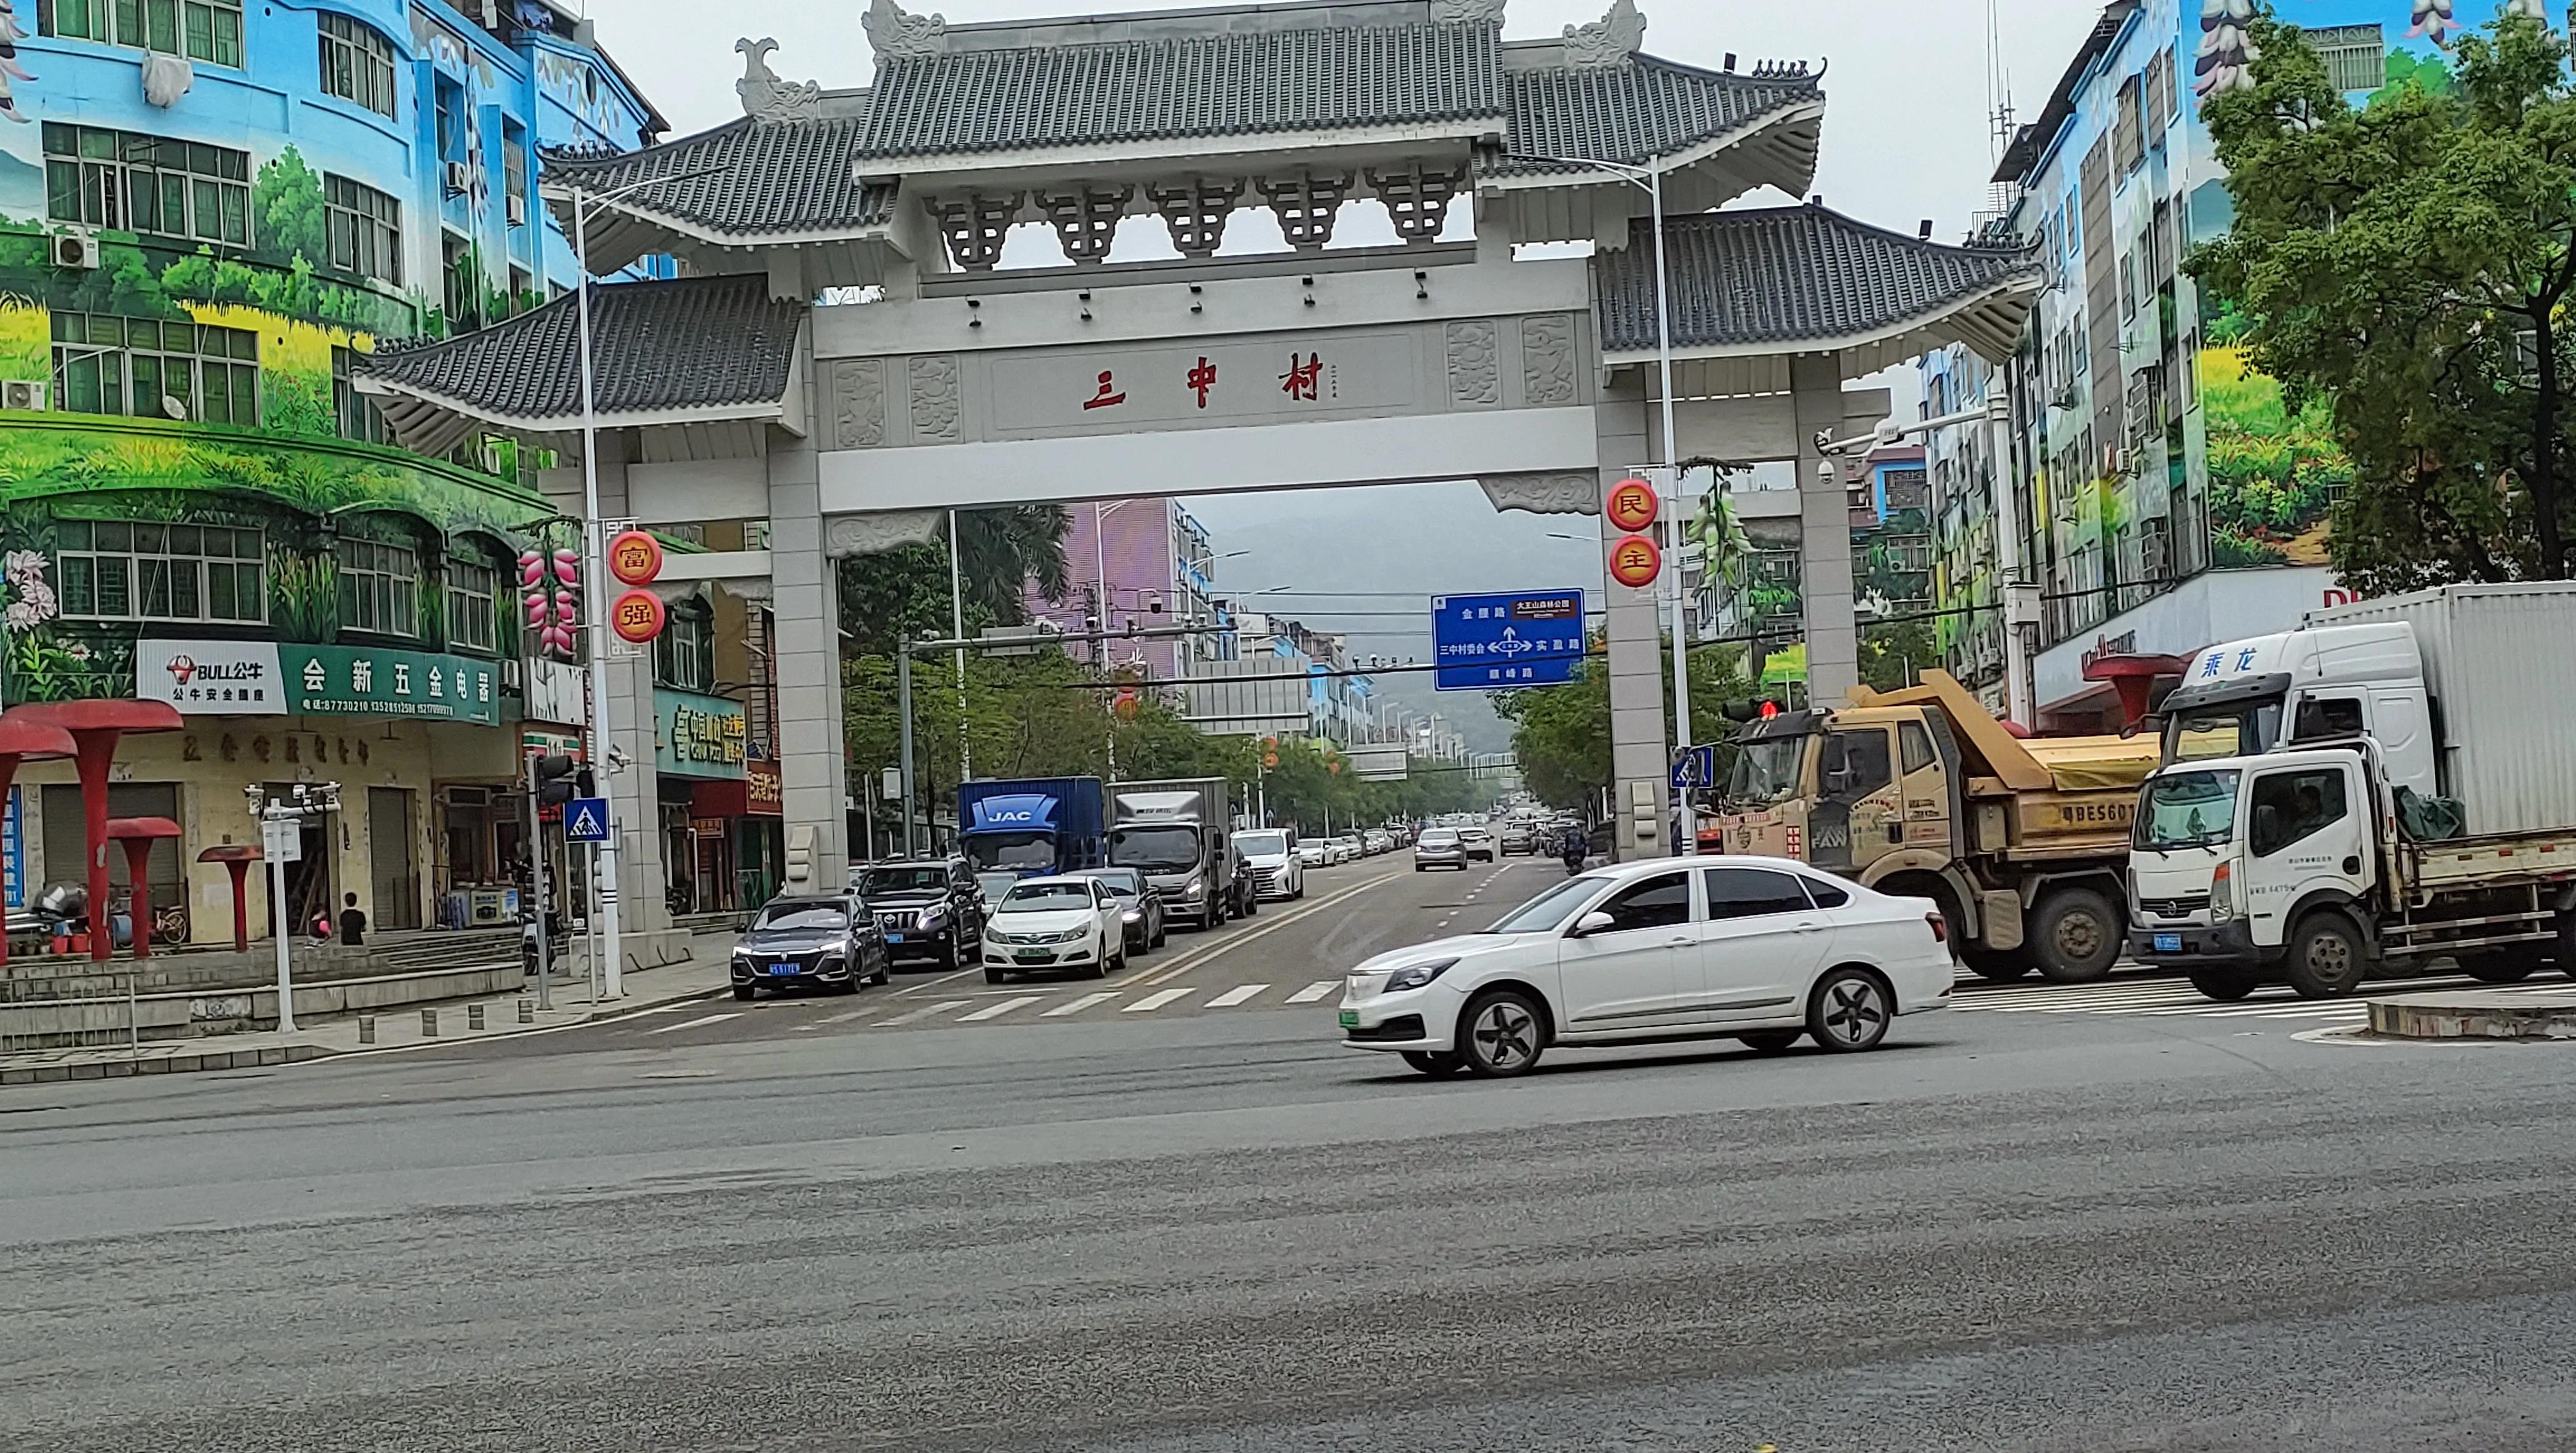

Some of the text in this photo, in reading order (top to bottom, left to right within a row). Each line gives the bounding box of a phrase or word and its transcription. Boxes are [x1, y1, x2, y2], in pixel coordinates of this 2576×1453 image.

[1084, 352, 1323, 410] 三中村
[1440, 643, 1485, 655] 三中村委会
[304, 658, 489, 703] 会新五金电器
[988, 811, 1032, 822] JAC
[1812, 825, 1847, 849] FAW
